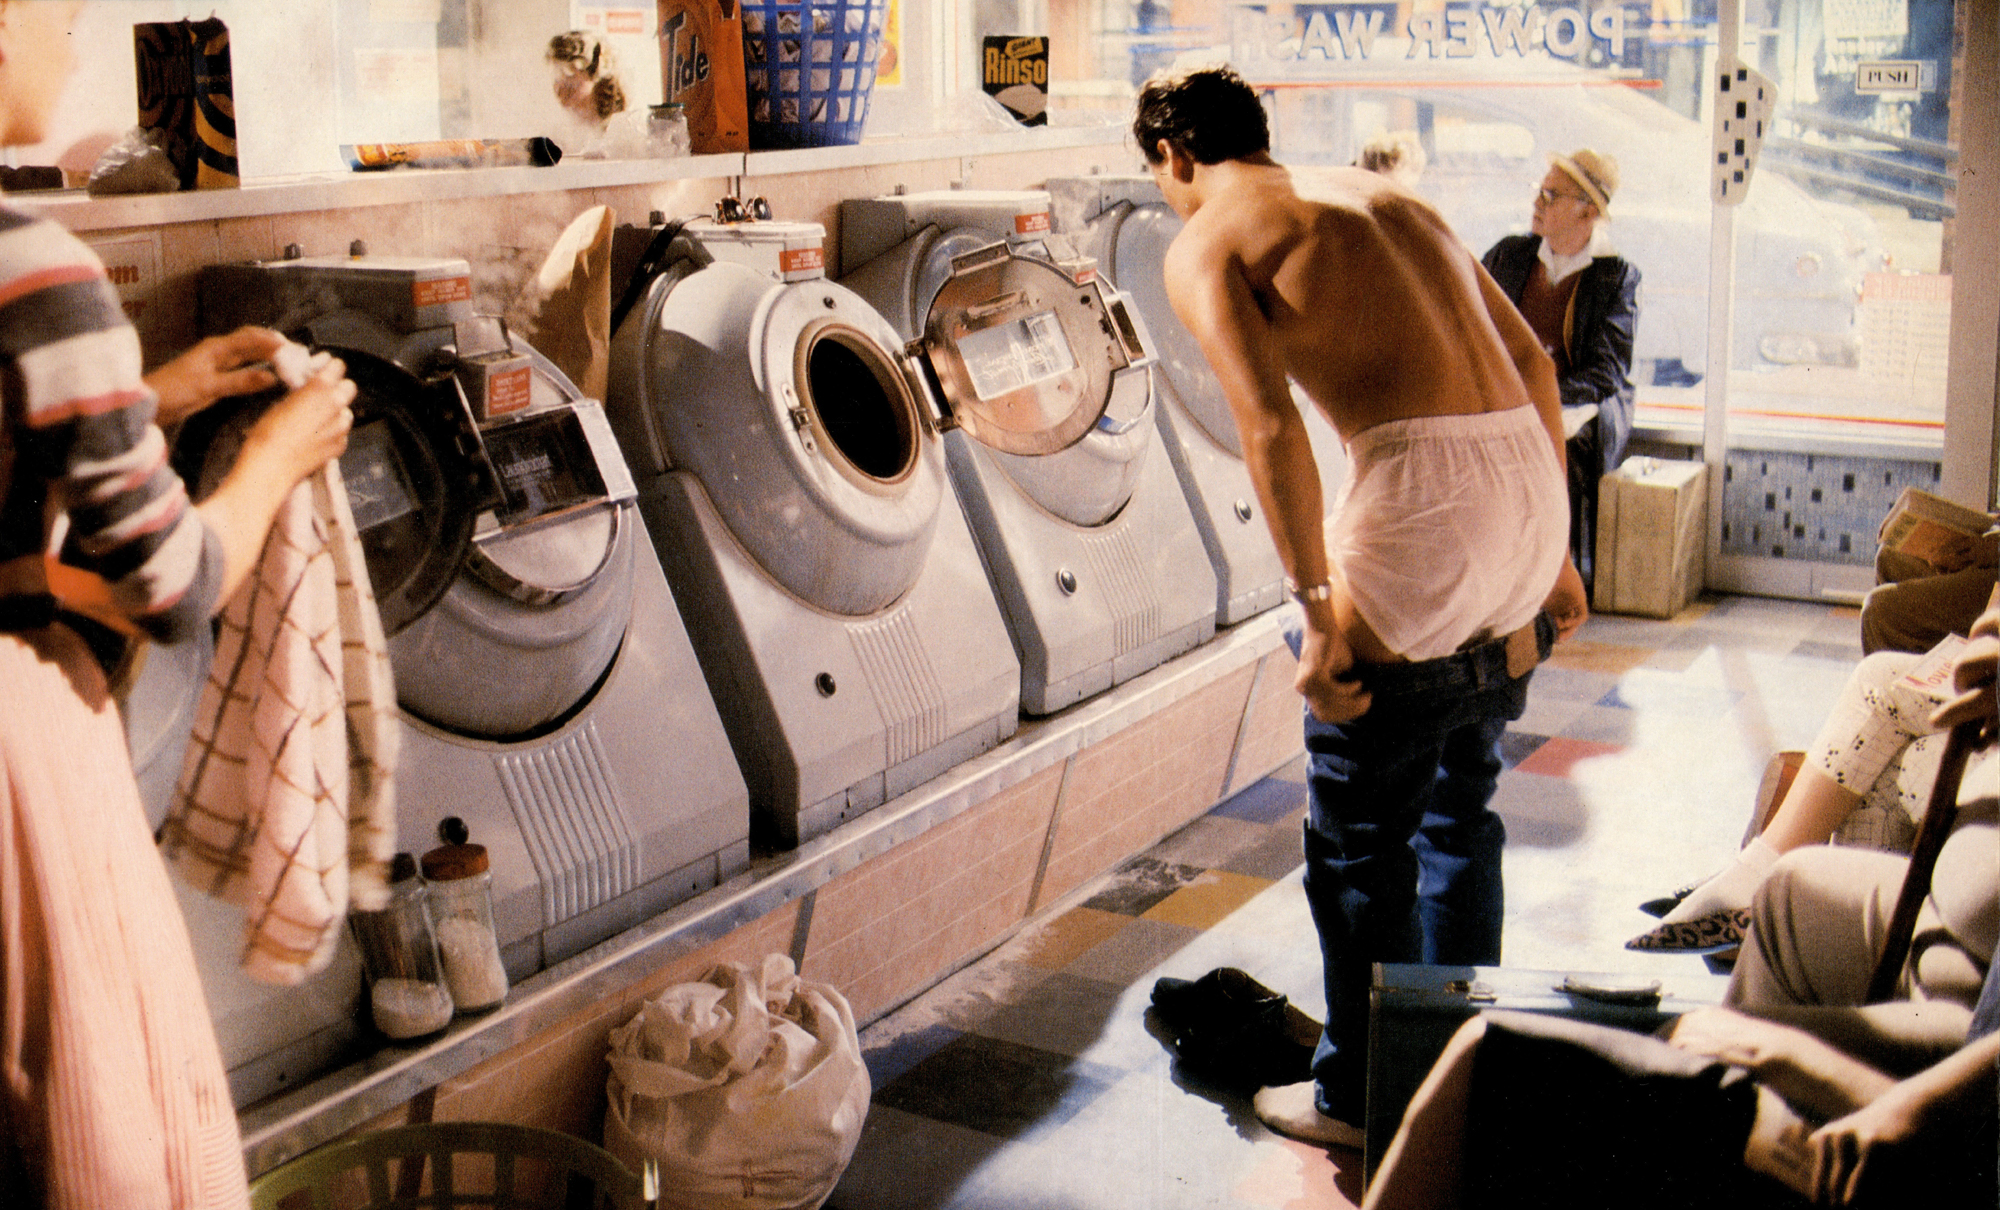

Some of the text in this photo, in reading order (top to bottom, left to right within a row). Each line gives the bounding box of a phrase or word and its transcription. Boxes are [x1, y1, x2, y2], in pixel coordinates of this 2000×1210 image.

[662, 11, 710, 103] Tide
[985, 47, 1047, 85] Rinso
[1868, 70, 1908, 82] PUSH
